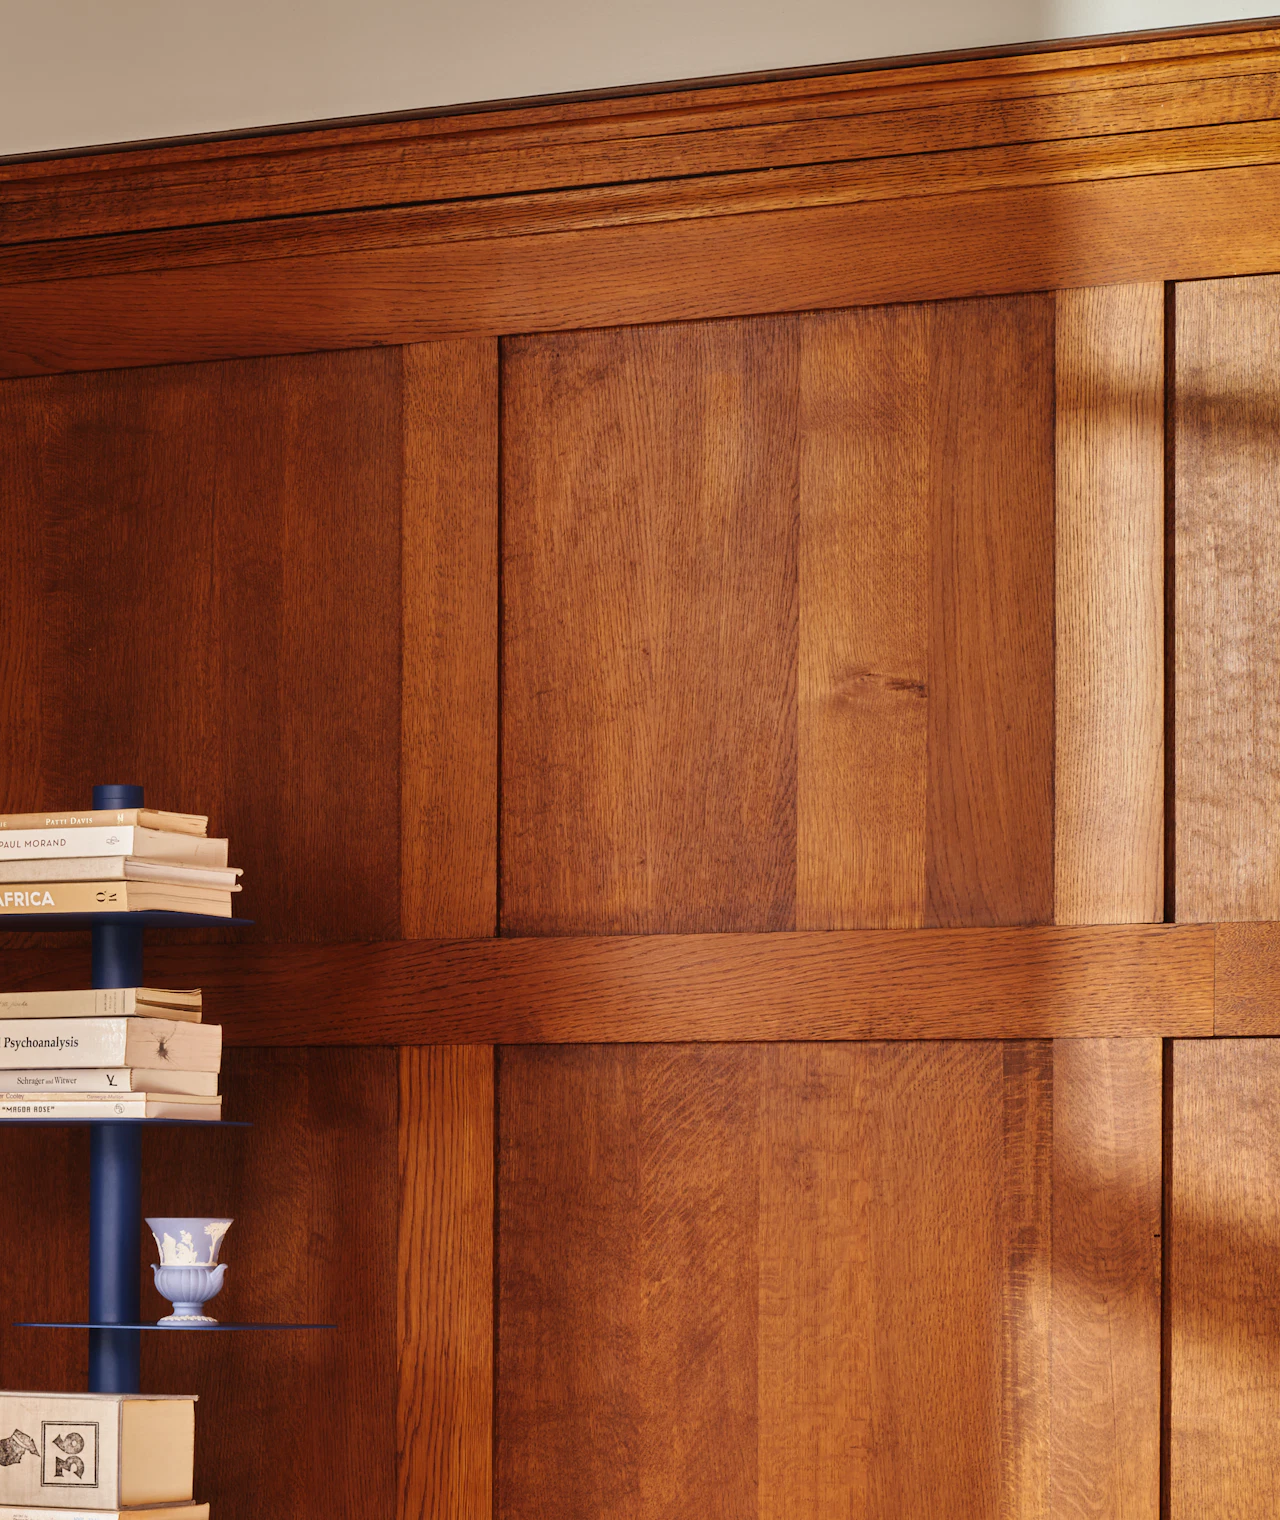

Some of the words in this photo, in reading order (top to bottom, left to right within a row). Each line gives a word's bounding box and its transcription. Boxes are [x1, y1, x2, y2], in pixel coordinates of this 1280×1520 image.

[45, 818, 67, 826] PATTI
[70, 817, 93, 825] DAVIS
[24, 838, 67, 847] MORAND
[3, 1036, 79, 1051] Psychoanalysis
[16, 1076, 45, 1086] Schrager
[54, 1076, 77, 1085] Witwer
[5, 1092, 25, 1100] Cooley
[52, 1432, 85, 1479] 36
